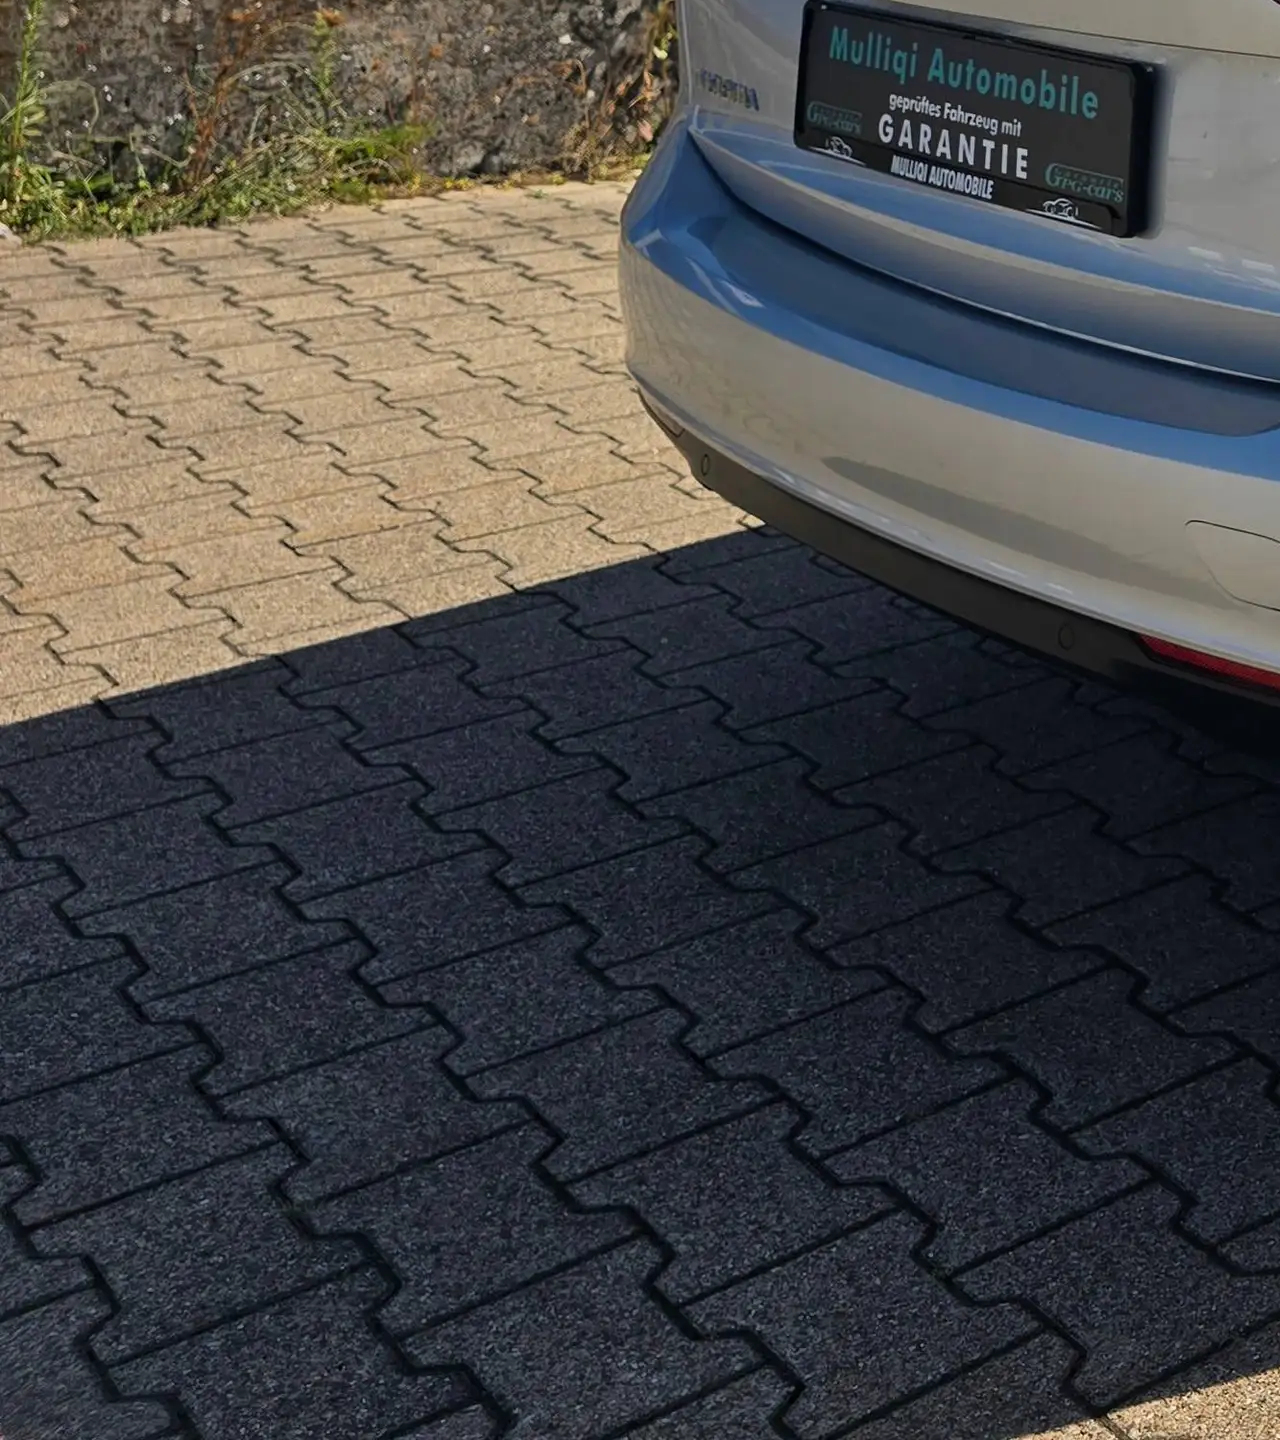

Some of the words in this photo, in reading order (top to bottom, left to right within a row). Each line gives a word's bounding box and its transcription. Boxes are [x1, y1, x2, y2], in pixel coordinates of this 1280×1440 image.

[829, 25, 918, 84] Mulliqi
[927, 48, 1099, 119] Automobile
[889, 93, 941, 118] geprüftes
[944, 102, 998, 136] Fahrzeug
[1001, 118, 1022, 137] mit
[878, 113, 1029, 180] GARANTIE
[890, 155, 927, 184] MULLIQI
[928, 163, 994, 200] AUTOMOBILE
